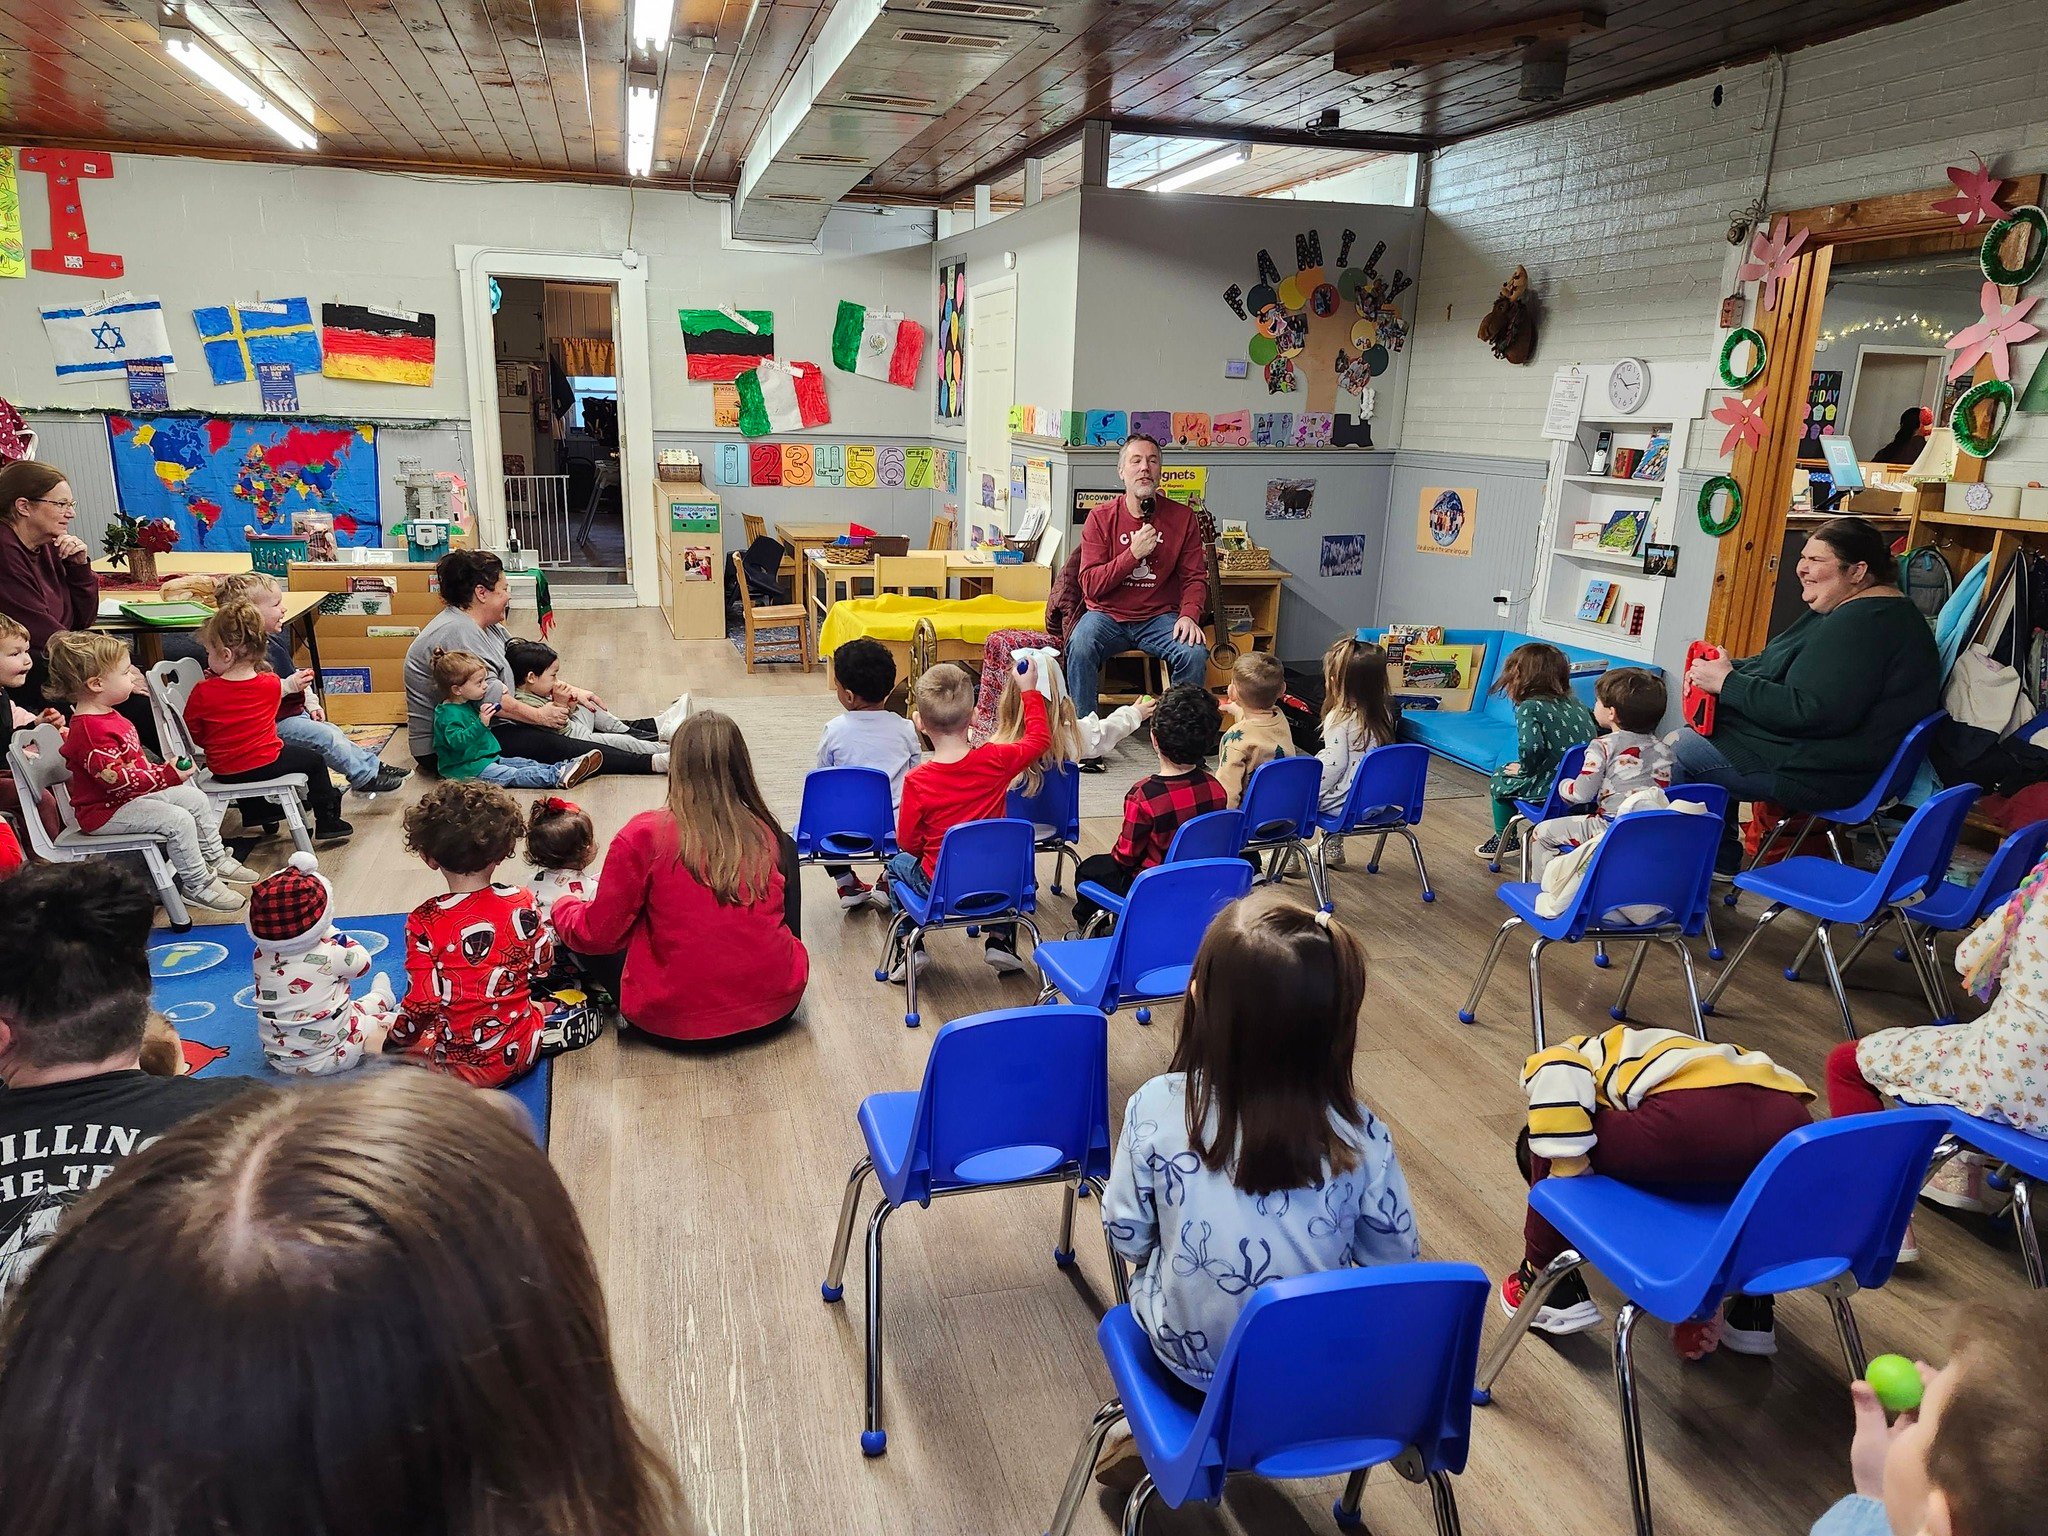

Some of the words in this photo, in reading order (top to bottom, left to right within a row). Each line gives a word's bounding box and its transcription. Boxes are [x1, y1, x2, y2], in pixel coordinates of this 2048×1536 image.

[1223, 228, 1413, 321] FAMILY
[752, 445, 781, 485] 2
[784, 445, 813, 486] 3
[815, 446, 844, 485] 4
[847, 447, 875, 487] 5
[849, 448, 859, 456] five
[877, 448, 906, 487] 6
[906, 448, 934, 488] 7
[817, 468, 828, 476] four
[1162, 470, 1196, 482] gnets
[674, 504, 716, 512] Manipulatives
[0, 1124, 166, 1166] ILLIN
